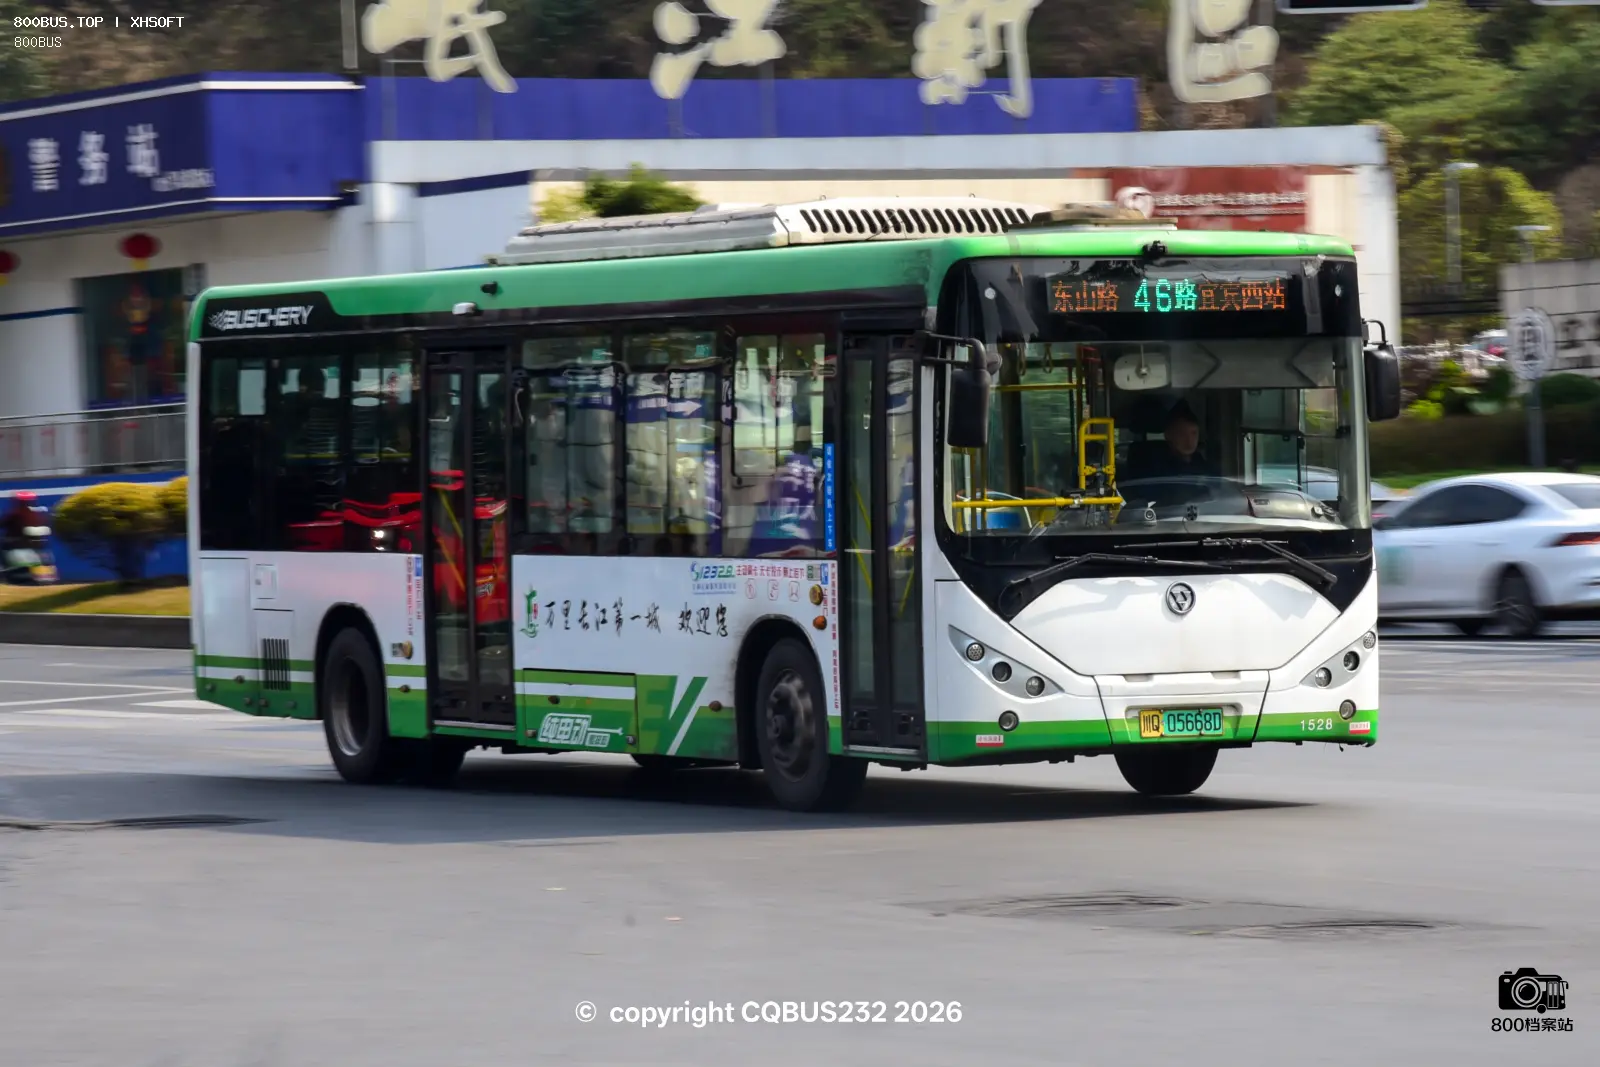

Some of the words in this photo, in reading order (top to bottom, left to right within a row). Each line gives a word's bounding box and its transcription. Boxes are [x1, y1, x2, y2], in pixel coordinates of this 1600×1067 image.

[1052, 280, 1120, 312] 东山路
[1134, 279, 1198, 312] 46路
[1198, 278, 1286, 310] 宜宾西站
[545, 597, 662, 637] 万里长江第一城
[678, 601, 728, 637] 欢迎您
[1167, 712, 1221, 732] 05668D
[1300, 718, 1333, 731] 1528
